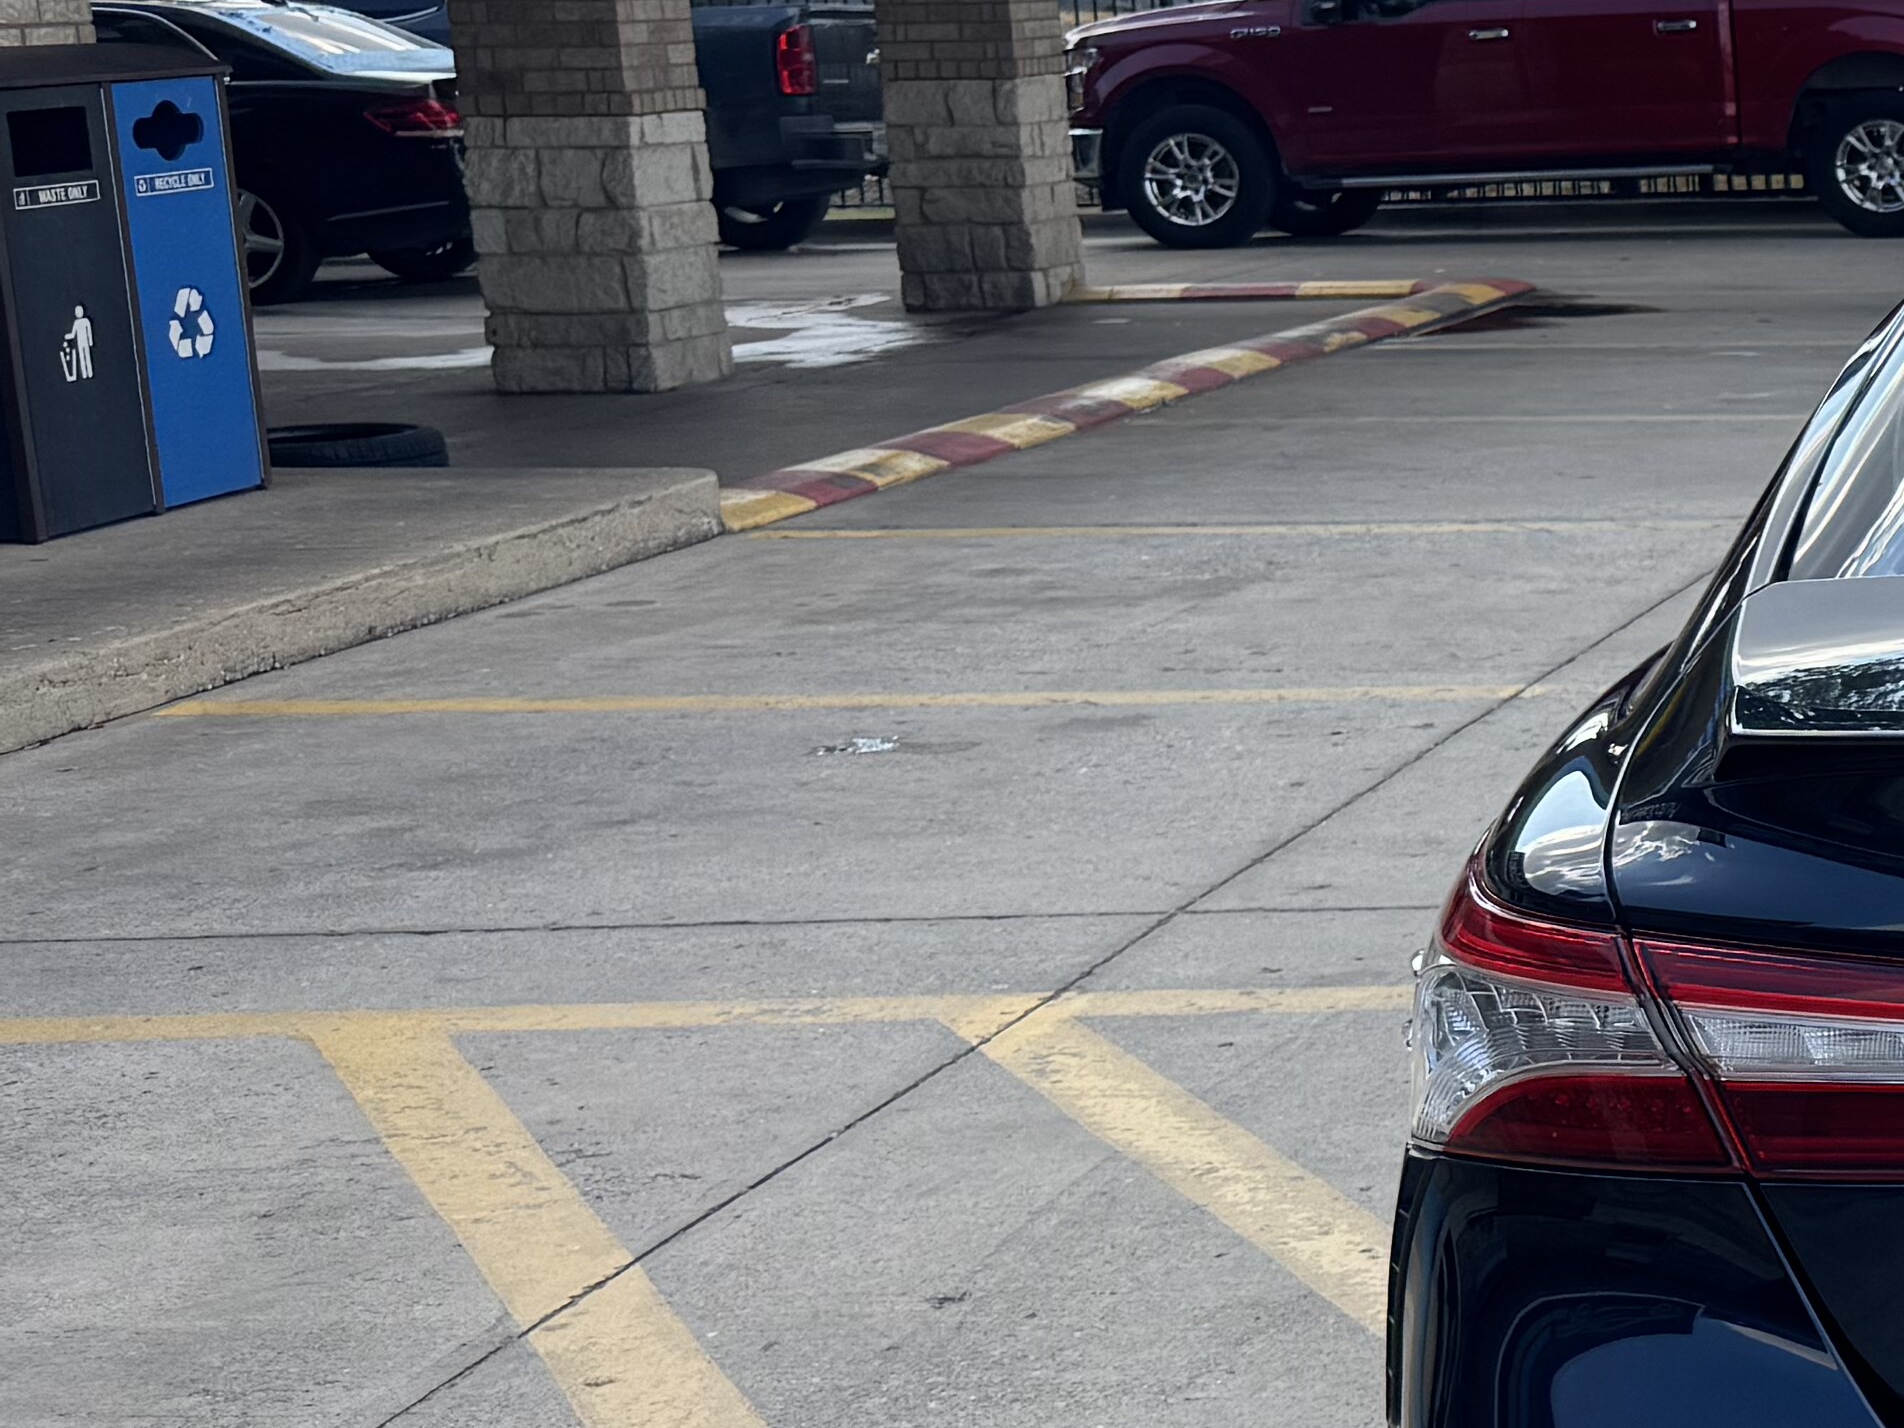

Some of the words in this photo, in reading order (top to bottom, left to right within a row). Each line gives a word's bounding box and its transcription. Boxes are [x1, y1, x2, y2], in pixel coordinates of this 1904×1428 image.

[154, 175, 186, 190] RECYCLE
[187, 173, 206, 188] ONLY
[38, 188, 66, 204] WASTE
[67, 185, 89, 200] ONLY
